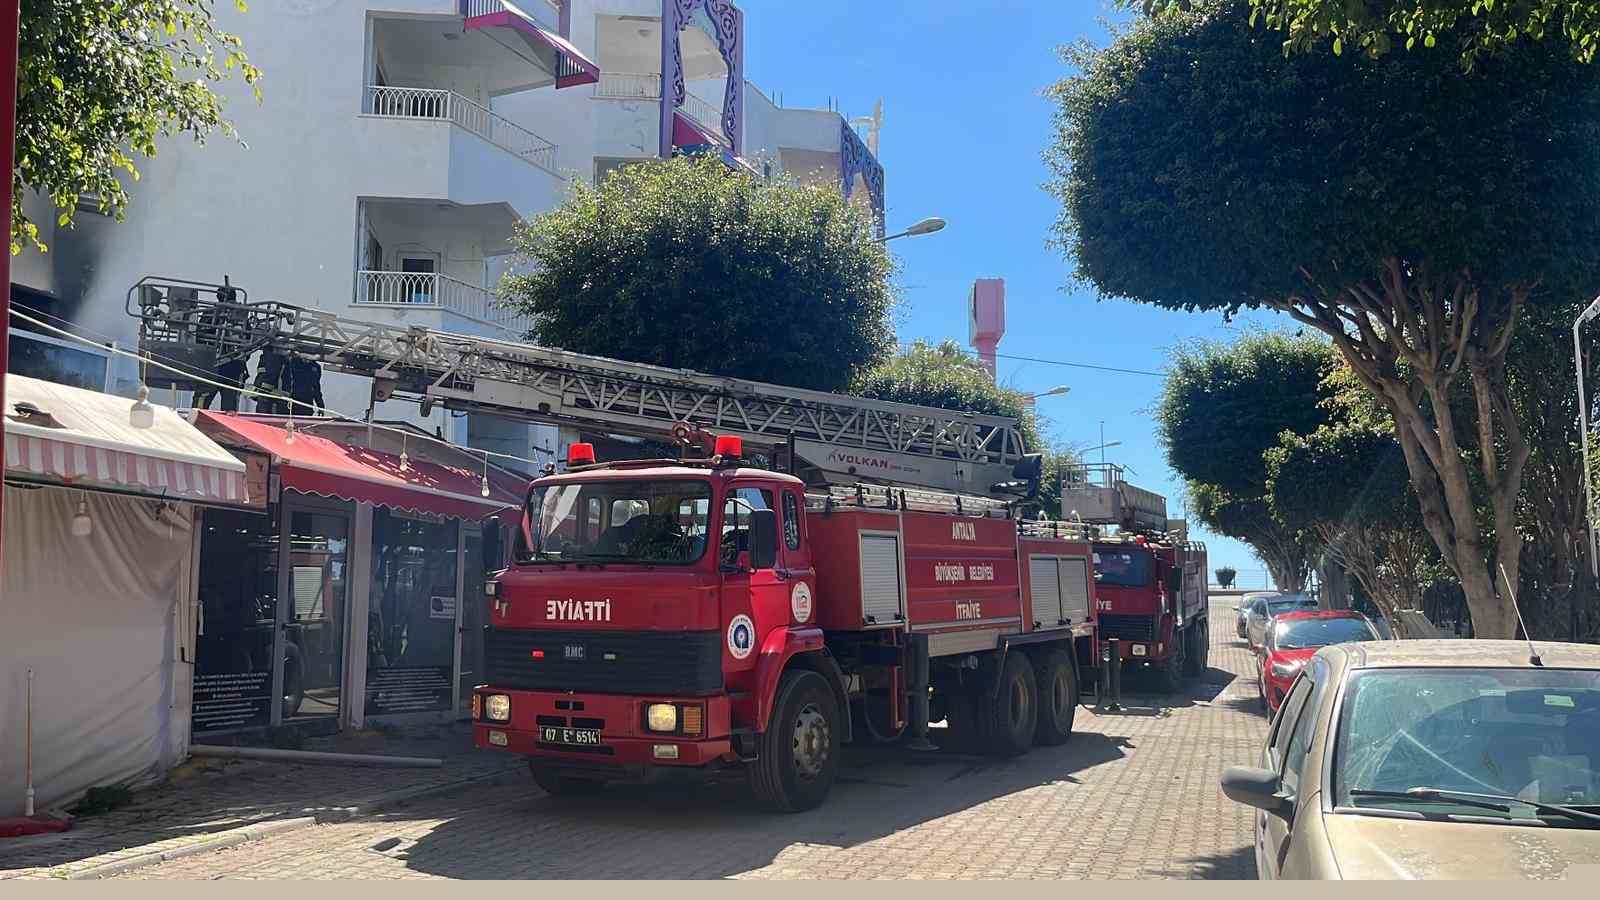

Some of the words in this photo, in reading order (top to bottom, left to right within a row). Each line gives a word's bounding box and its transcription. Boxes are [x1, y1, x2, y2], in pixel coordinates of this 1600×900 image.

[838, 453, 888, 469] VOLKAN
[952, 521, 976, 541] ANTALYA
[955, 599, 981, 620] İTFAİYE
[1095, 598, 1113, 610] İYE
[545, 728, 556, 741] 07
[576, 730, 597, 744] 6514
